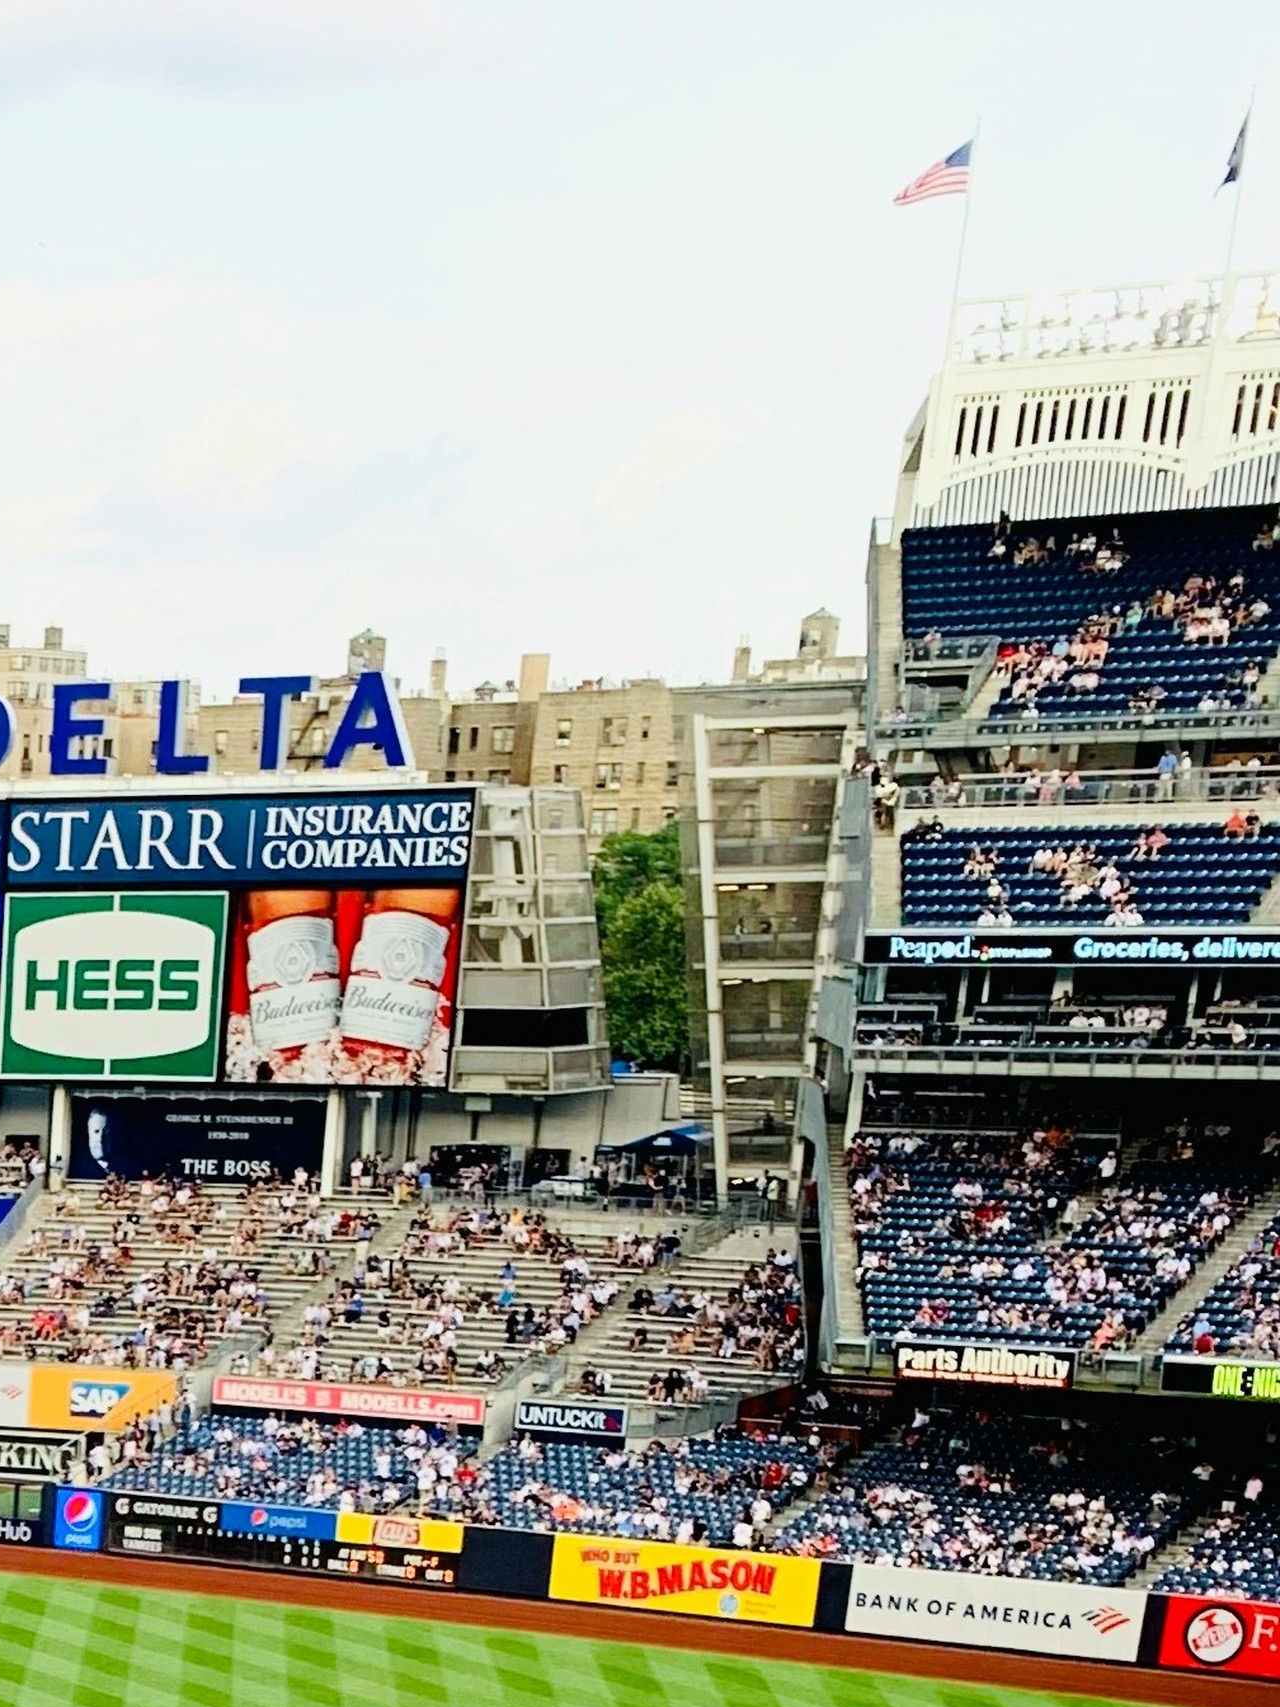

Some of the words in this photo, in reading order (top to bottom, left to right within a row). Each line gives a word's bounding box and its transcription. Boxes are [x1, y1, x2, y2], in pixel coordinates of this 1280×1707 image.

[8, 806, 236, 874] STARR
[262, 801, 472, 835] INSURANCE
[260, 835, 470, 871] COMPANIES
[890, 935, 973, 966] Peapod
[1072, 937, 1190, 962] Groceries,
[25, 957, 200, 1012] HESS
[181, 1158, 218, 1175] THE
[223, 1159, 272, 1177] BOSS
[897, 1347, 958, 1372] Parts
[960, 1347, 1070, 1379] Authority
[69, 1383, 121, 1417] SAP
[221, 1384, 307, 1406] MODELL'S
[340, 1393, 476, 1420] MODELLS.com
[520, 1405, 606, 1428] UNTUCKit
[133, 1500, 198, 1520] GATORADE
[269, 1513, 308, 1530] pepsi
[580, 1549, 610, 1564] WHO
[613, 1551, 639, 1565] BUT
[855, 1591, 919, 1614] BANK
[926, 1596, 957, 1618] OF
[962, 1601, 1073, 1631] AMERICA
